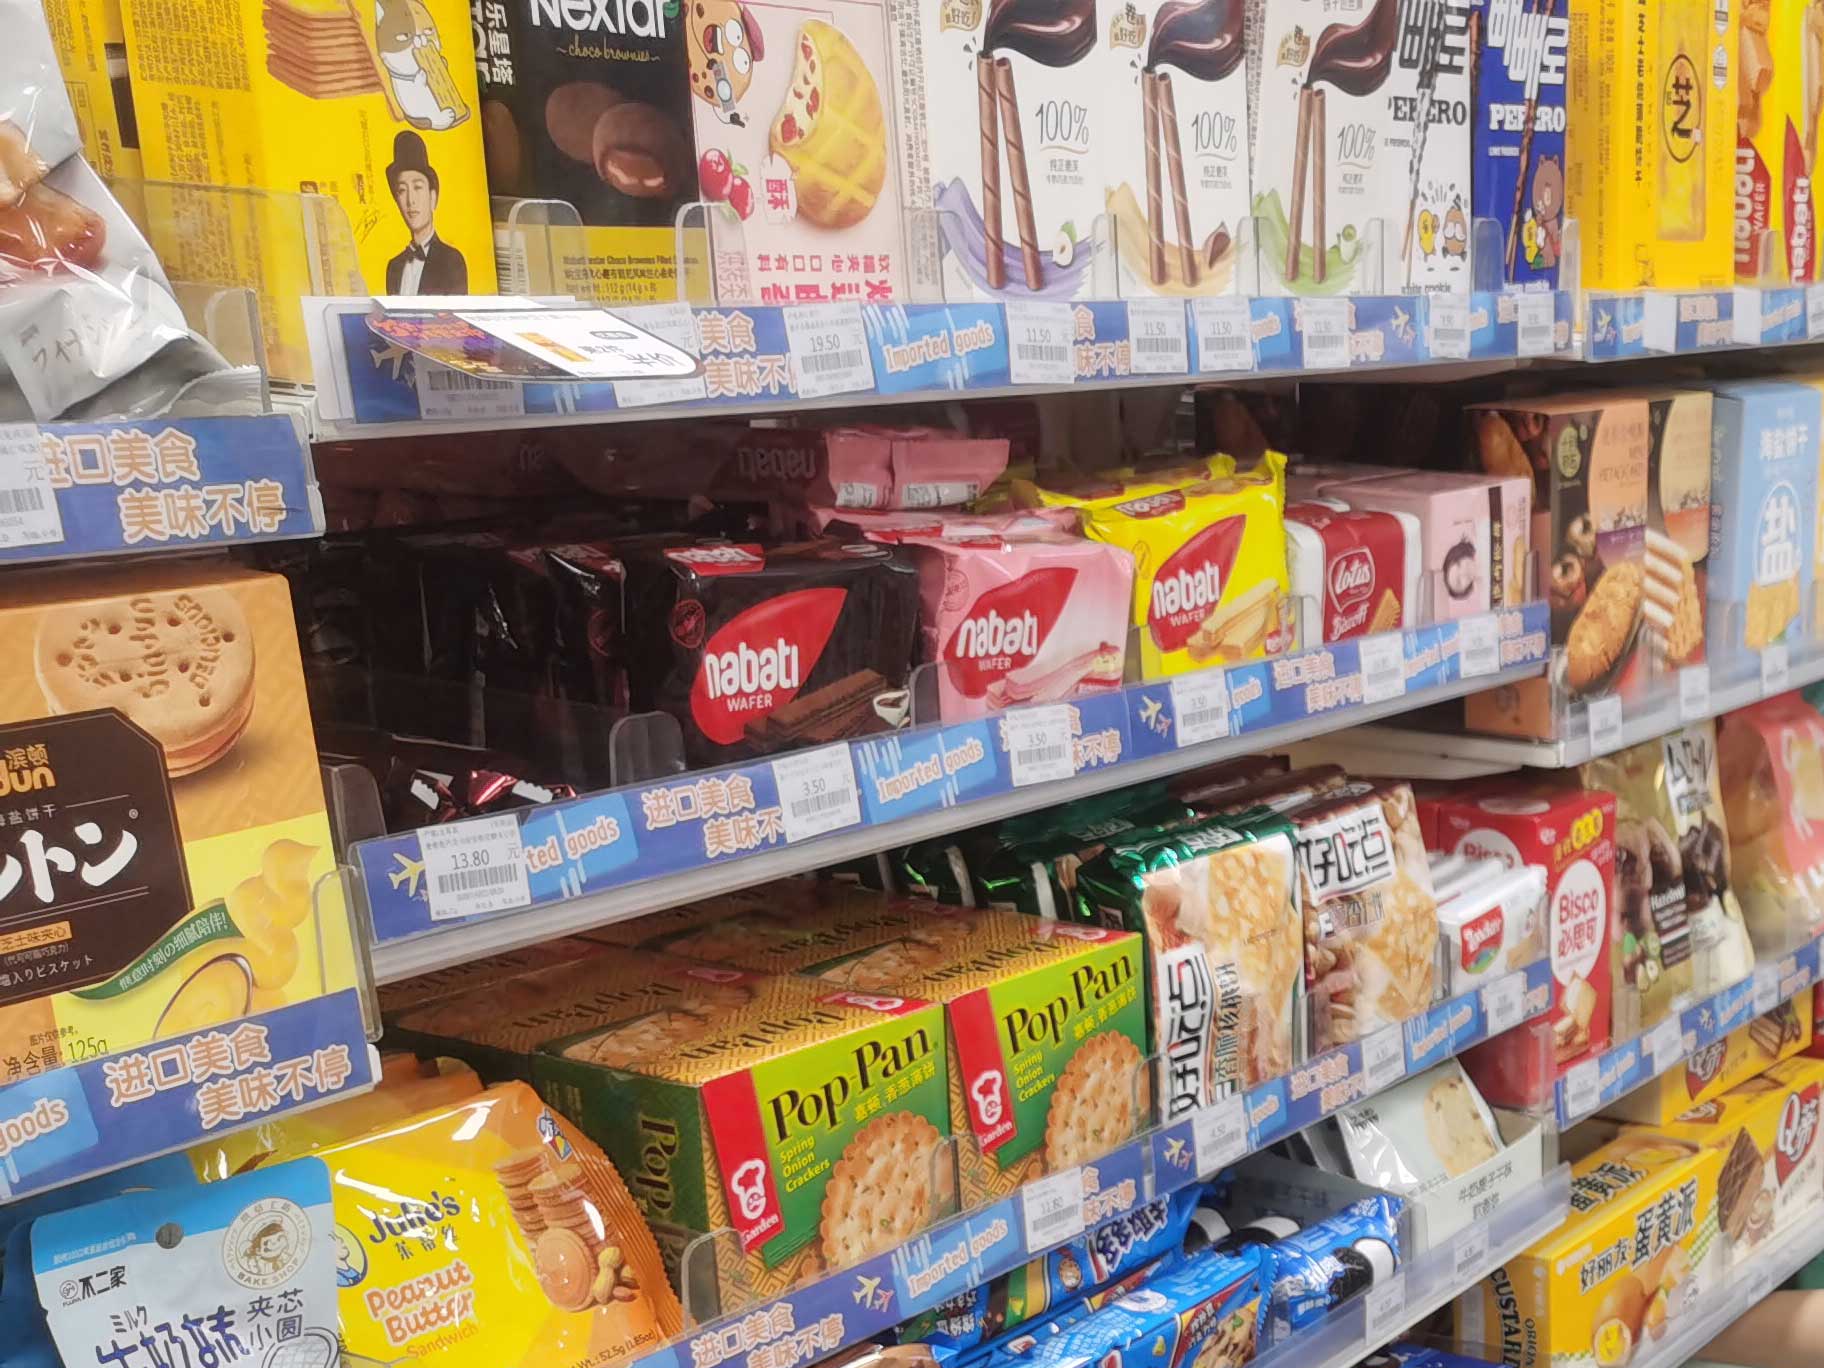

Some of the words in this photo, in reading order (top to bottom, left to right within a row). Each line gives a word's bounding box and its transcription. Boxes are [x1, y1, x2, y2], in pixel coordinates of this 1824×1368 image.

[1036, 100, 1089, 145] 100%
[1192, 112, 1238, 154] 100%
[809, 333, 841, 352] 19.50
[883, 331, 950, 373] Imported
[953, 321, 994, 359] goods
[1026, 326, 1052, 344] 11.50
[1143, 321, 1168, 337] 11.50
[118, 479, 286, 544] 美味不停
[1153, 560, 1221, 621] nabati
[1334, 559, 1371, 594] Lotus
[956, 606, 1038, 659] nabati
[706, 638, 799, 698] nabati
[727, 694, 773, 713] WAFER
[801, 778, 826, 794] 3.50
[877, 756, 942, 803] Imported
[943, 736, 984, 777] goods
[643, 773, 755, 832] 进口美食
[566, 816, 621, 859] goods
[451, 849, 490, 870] 13.80
[1558, 889, 1600, 925] Bisco
[104, 1022, 271, 1106] 进口美食
[1013, 1049, 1043, 1076] Spring
[1016, 1063, 1044, 1089] Onion
[199, 1044, 352, 1129] 美味不停
[768, 1022, 932, 1144] Pop-Pan
[779, 1135, 816, 1166] Spring
[781, 1150, 816, 1179] Onion
[785, 1157, 831, 1194] Crackers
[368, 1191, 461, 1245] Julie's
[1633, 1179, 1698, 1270] 蛋黄派
[907, 1243, 967, 1298] Imported
[970, 1216, 1009, 1256] goods
[78, 1266, 127, 1299] 不二家
[237, 1270, 276, 1288] BAKE
[365, 1259, 472, 1319] Peanut
[113, 1305, 148, 1333] ミルク
[247, 1288, 304, 1318] 夹芯
[385, 1289, 474, 1345] Butter
[248, 1318, 304, 1352] 小圆
[406, 1322, 479, 1361] Sandwich
